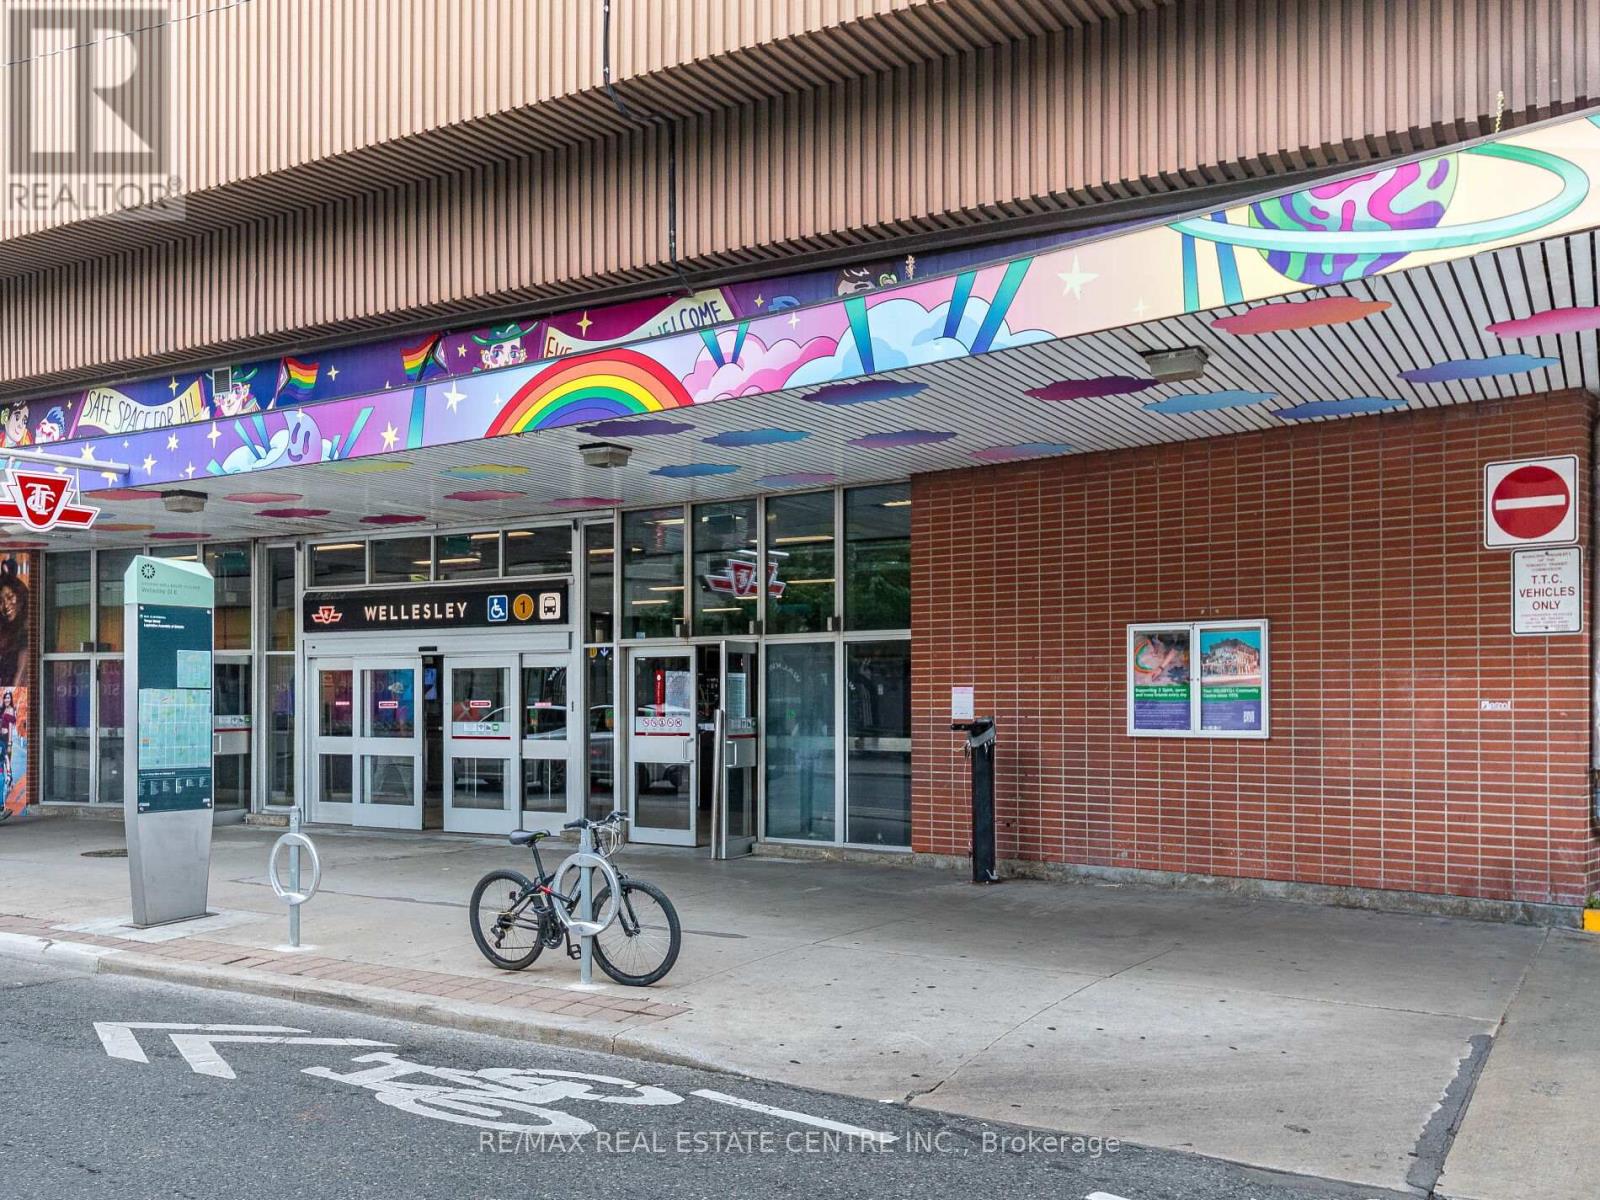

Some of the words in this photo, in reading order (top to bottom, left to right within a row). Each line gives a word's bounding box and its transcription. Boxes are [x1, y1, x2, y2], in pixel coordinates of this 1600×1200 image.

[83, 390, 114, 426] SAFE
[179, 391, 200, 424] ALL
[1531, 574, 1562, 584] T.T.C.
[1519, 586, 1575, 598] VEHICLES
[1532, 600, 1560, 610] ONLY
[364, 602, 467, 621] WELLESLEY
